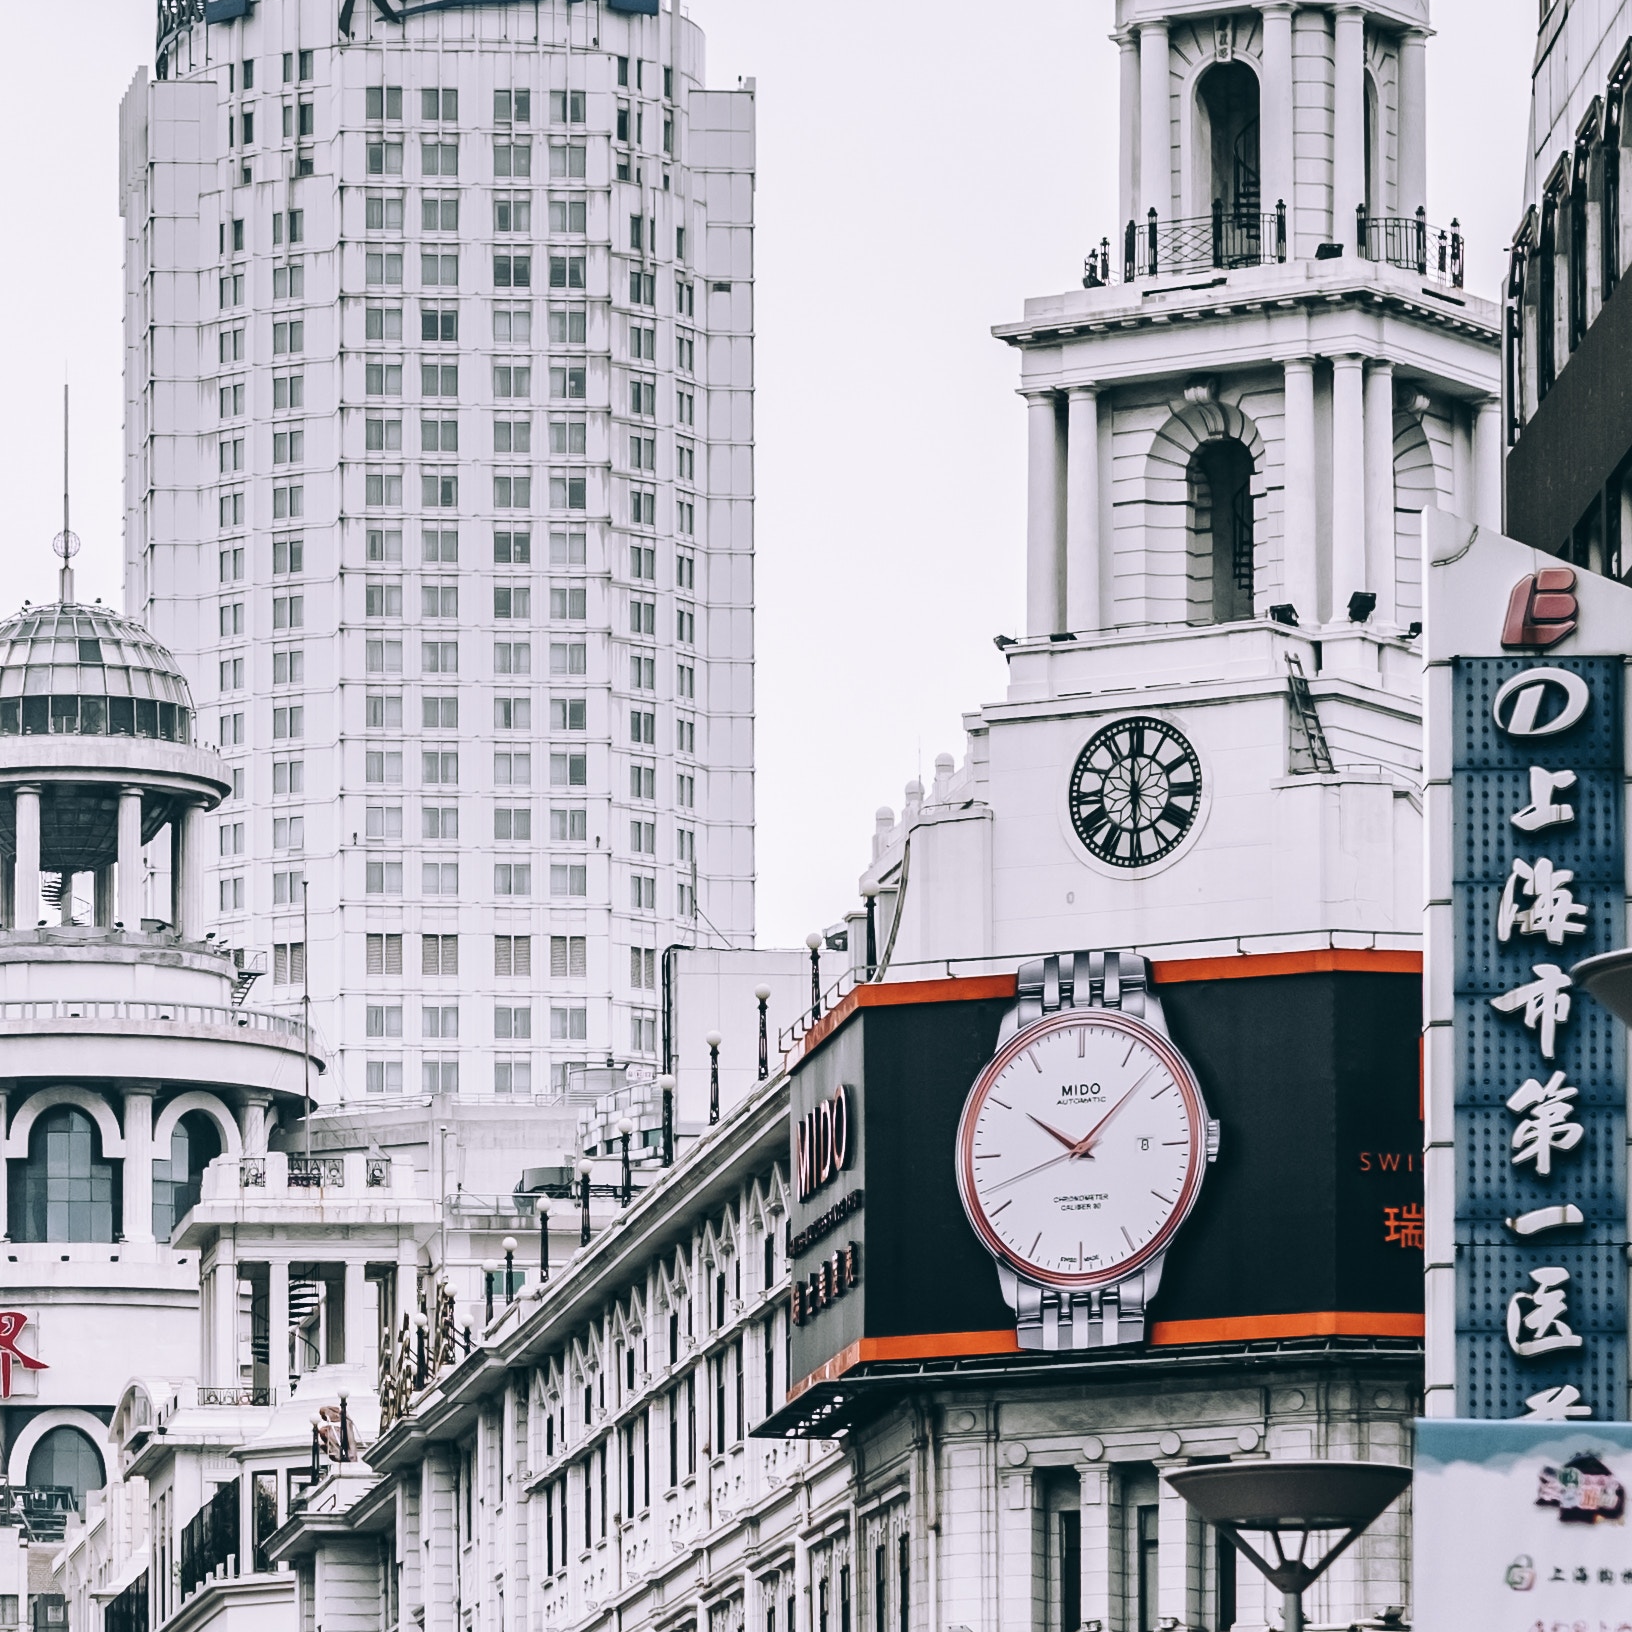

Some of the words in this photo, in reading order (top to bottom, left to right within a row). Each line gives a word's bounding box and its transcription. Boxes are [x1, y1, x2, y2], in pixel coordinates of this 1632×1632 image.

[1061, 1082, 1101, 1096] MIDO
[1056, 1096, 1107, 1106] AUTOMATIC
[796, 1084, 848, 1204] MIDO
[1359, 1151, 1424, 1172] SWI
